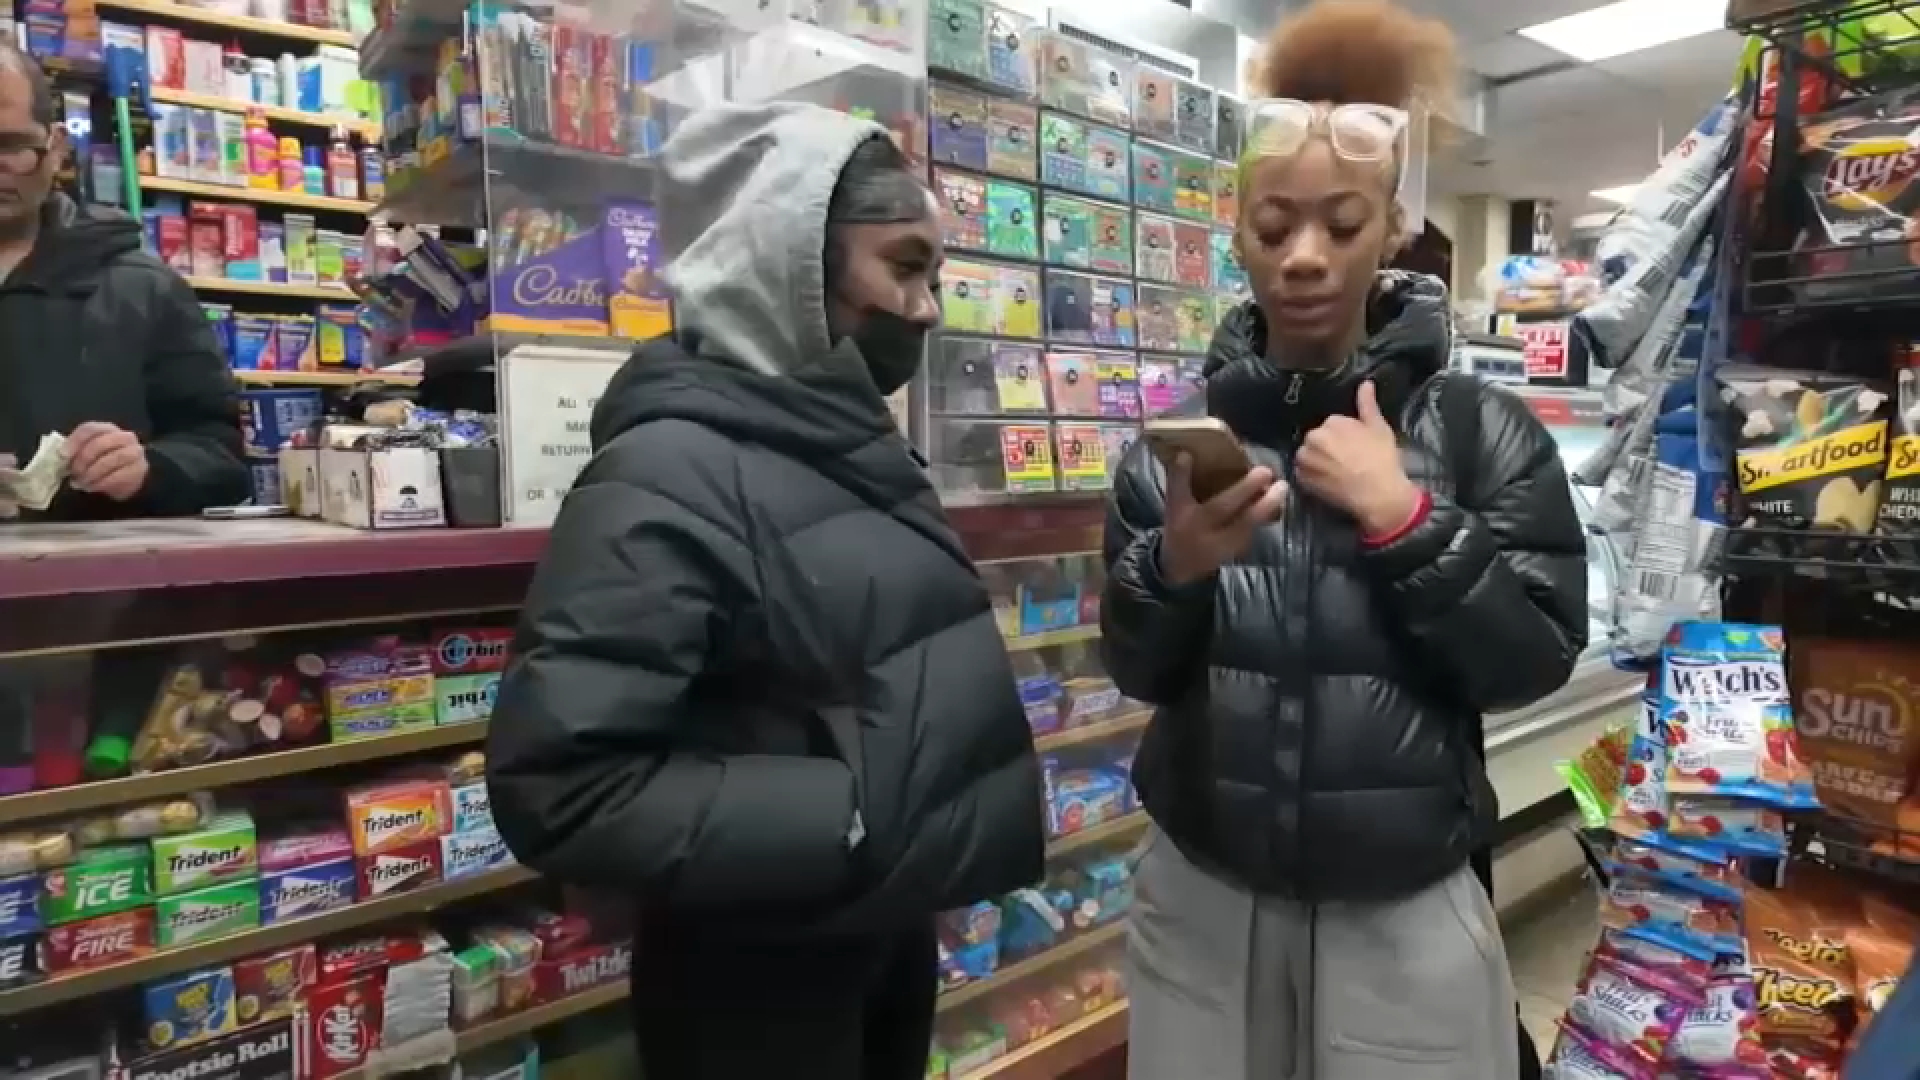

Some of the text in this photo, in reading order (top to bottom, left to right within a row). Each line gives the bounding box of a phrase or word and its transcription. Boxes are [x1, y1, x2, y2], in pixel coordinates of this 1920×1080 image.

[513, 263, 606, 307] Cadb
[1799, 687, 1905, 738] Sun
[363, 810, 424, 833] Trident
[462, 799, 491, 815] Trid
[168, 845, 241, 872] Trident
[367, 857, 432, 881] Trident
[74, 878, 132, 911] ICE
[272, 876, 342, 904] Trident
[71, 932, 133, 962] FIRE
[238, 1031, 289, 1062] Roll
